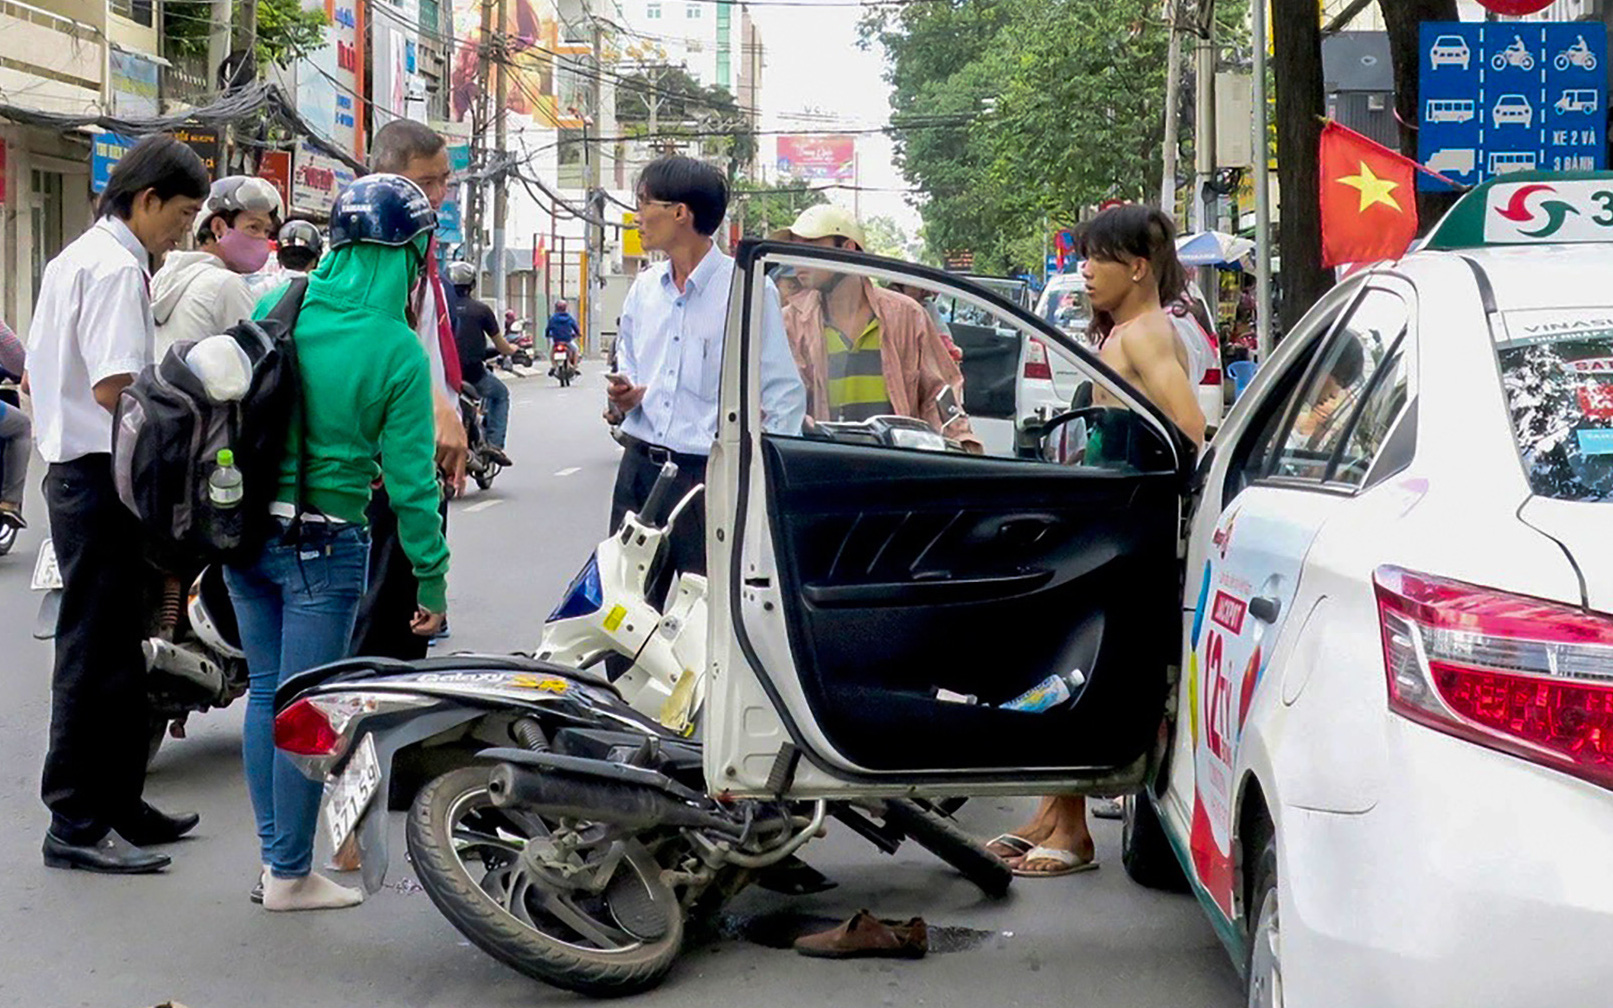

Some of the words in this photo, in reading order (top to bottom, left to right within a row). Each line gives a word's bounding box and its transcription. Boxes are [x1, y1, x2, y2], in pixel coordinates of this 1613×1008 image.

[1552, 130, 1568, 146] XE
[1570, 130, 1578, 146] 2
[1581, 126, 1597, 146] VÀ
[1553, 156, 1561, 171] 3
[1564, 152, 1594, 171] BÁNH
[1591, 190, 1613, 227] 3
